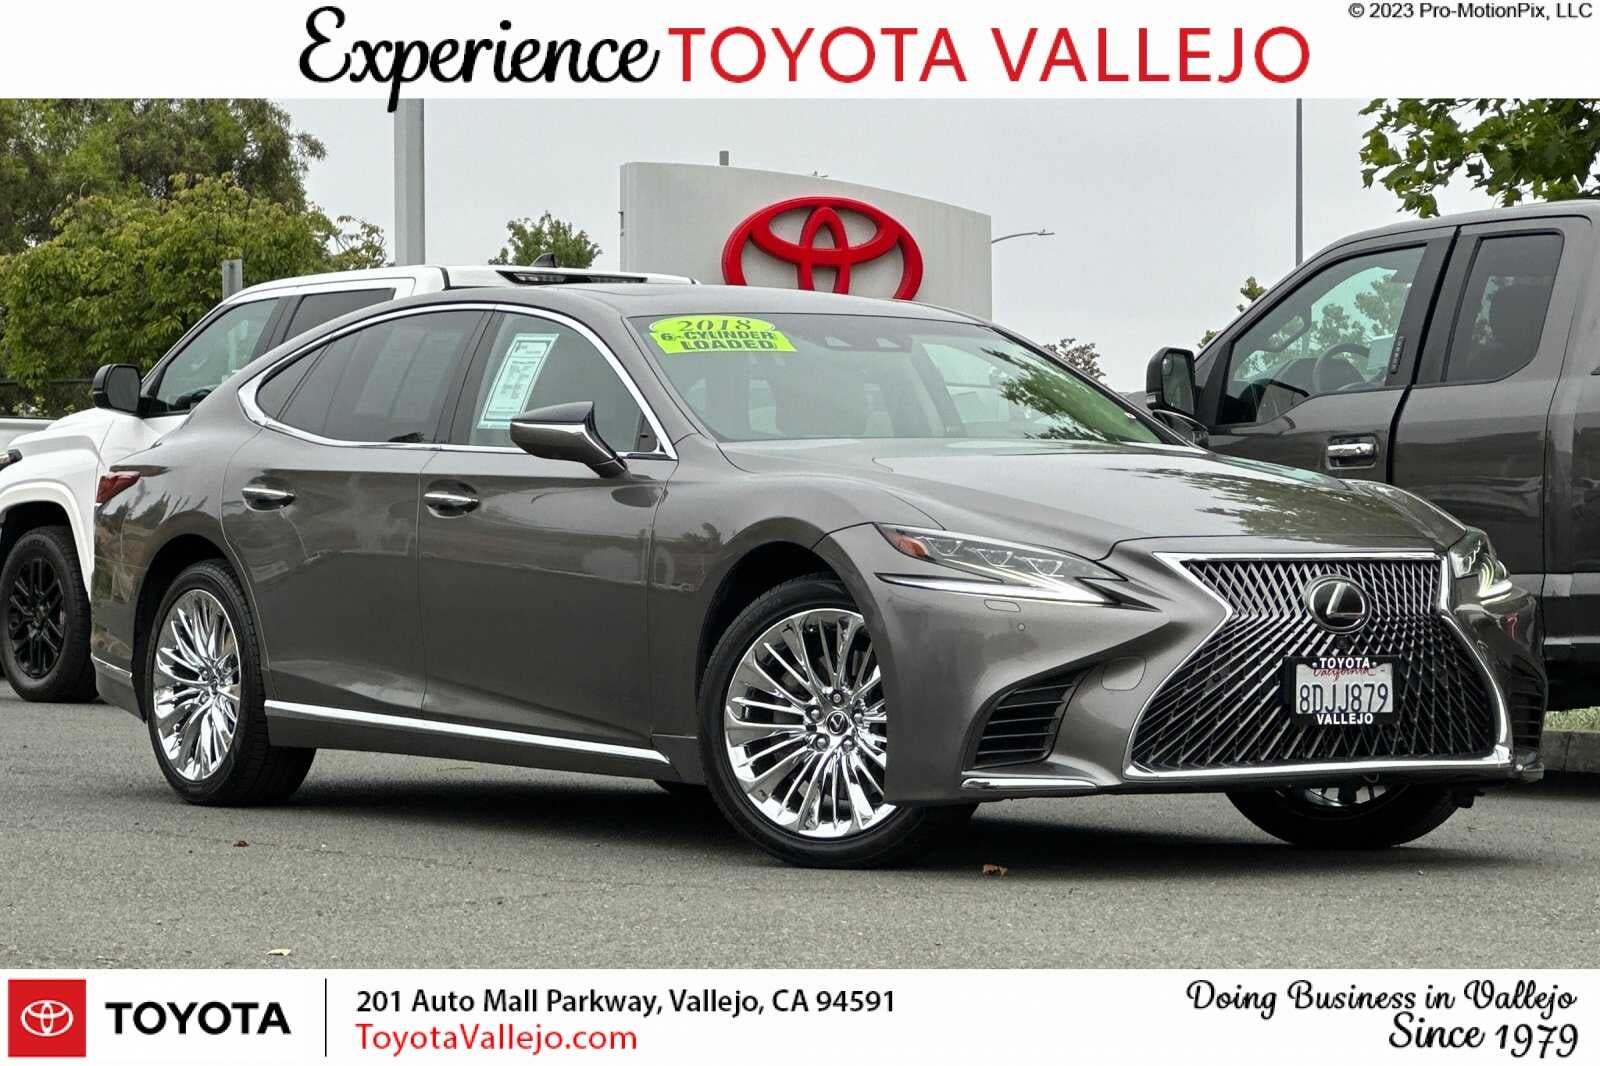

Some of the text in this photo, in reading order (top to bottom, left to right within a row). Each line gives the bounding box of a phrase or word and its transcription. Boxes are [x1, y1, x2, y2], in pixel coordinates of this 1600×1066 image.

[678, 319, 752, 332] 2018
[660, 331, 775, 342] 6-CYLINDER
[680, 339, 777, 350] LOADED
[1319, 657, 1370, 669] TOYOTA
[1299, 683, 1389, 713] 8DJJ879
[1316, 713, 1374, 725] VALLEJO
